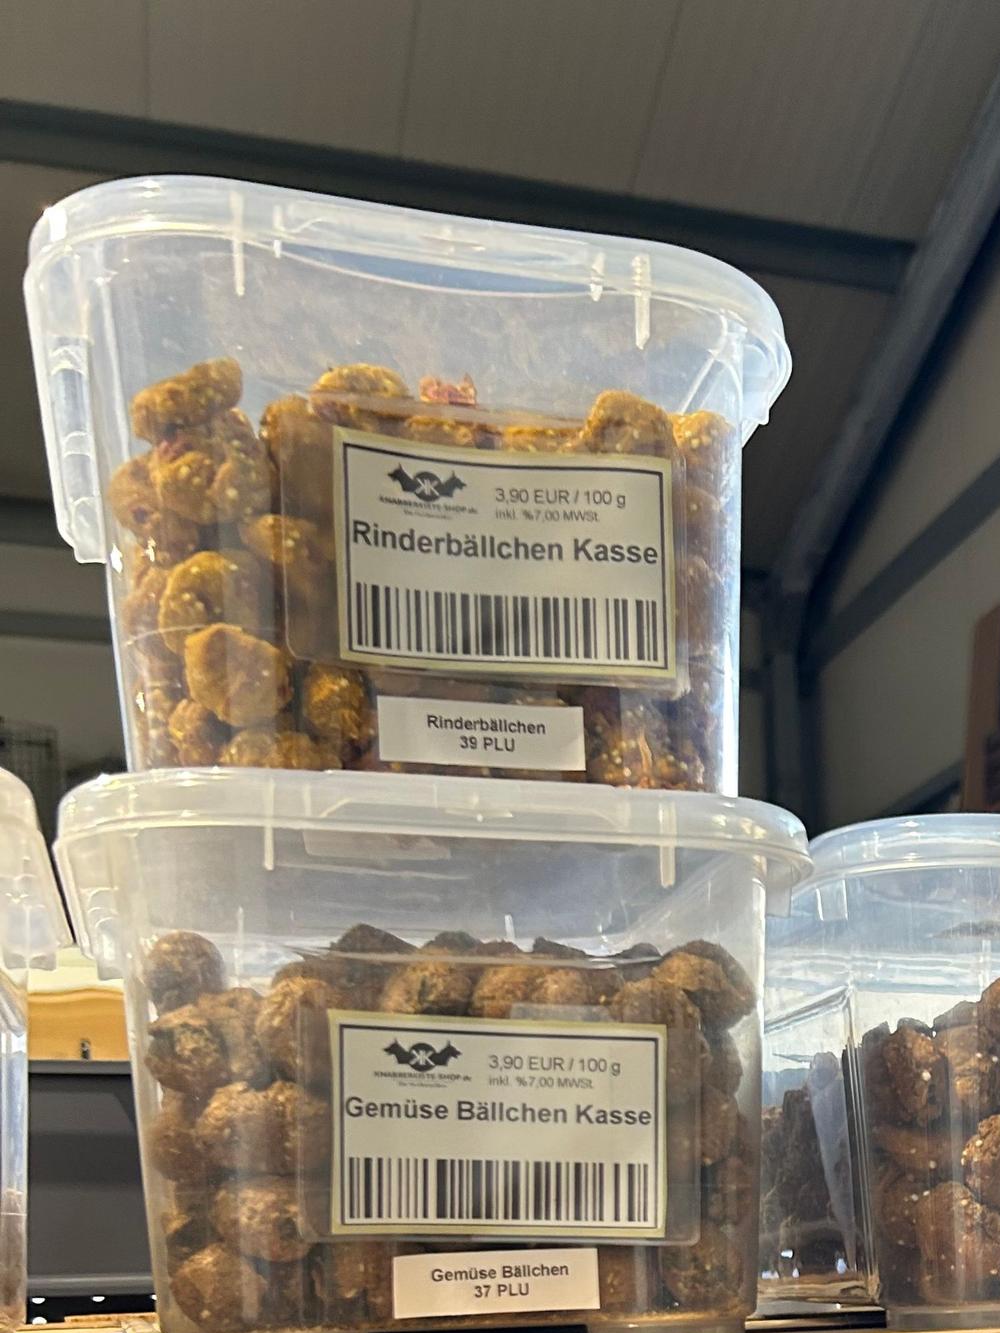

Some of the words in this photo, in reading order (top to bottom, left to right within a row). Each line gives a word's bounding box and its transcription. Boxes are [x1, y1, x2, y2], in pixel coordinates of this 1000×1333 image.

[495, 488, 529, 504] 3,90
[535, 489, 570, 504] EUR
[584, 490, 612, 505] 100
[617, 495, 626, 509] g
[352, 520, 564, 561] Rinderbällchen
[574, 538, 659, 565] Kasse
[427, 715, 546, 735] Rinderbällchen
[460, 736, 478, 750] 39
[484, 737, 515, 752] PLU
[488, 1054, 523, 1071] 3,90
[528, 1056, 564, 1071] EUR
[579, 1058, 608, 1073] 100
[611, 1062, 621, 1076] g
[516, 1076, 554, 1089] %7,00
[345, 1097, 449, 1120] Gemüse
[457, 1101, 567, 1124] Bällchen
[576, 1104, 653, 1126] Kasse
[431, 1266, 497, 1283] Gemüse
[502, 1263, 569, 1279] Bällchen
[474, 1286, 491, 1298] 37
[497, 1284, 530, 1298] PLU
